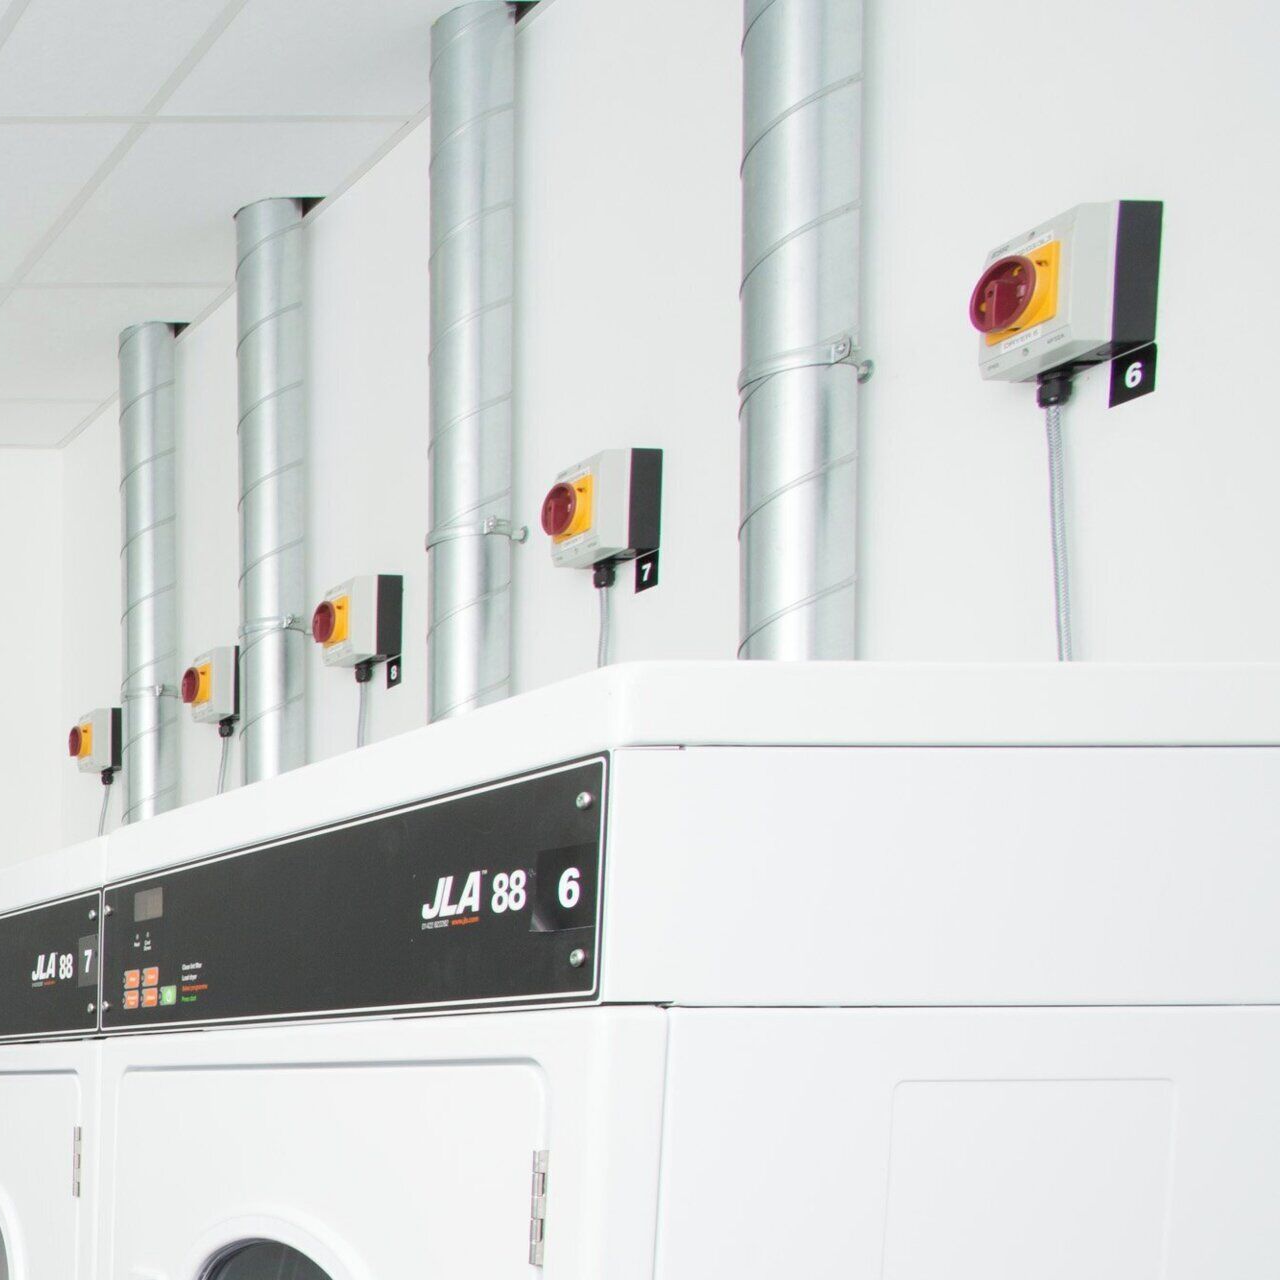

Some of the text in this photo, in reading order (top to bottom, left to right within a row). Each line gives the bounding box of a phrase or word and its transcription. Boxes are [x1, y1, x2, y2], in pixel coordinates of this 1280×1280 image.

[1124, 361, 1143, 389] 6
[641, 562, 652, 582] 7
[390, 665, 397, 680] 8
[421, 867, 580, 920] JLA 88 6
[31, 952, 73, 981] JLA 88
[84, 949, 92, 973] 7
